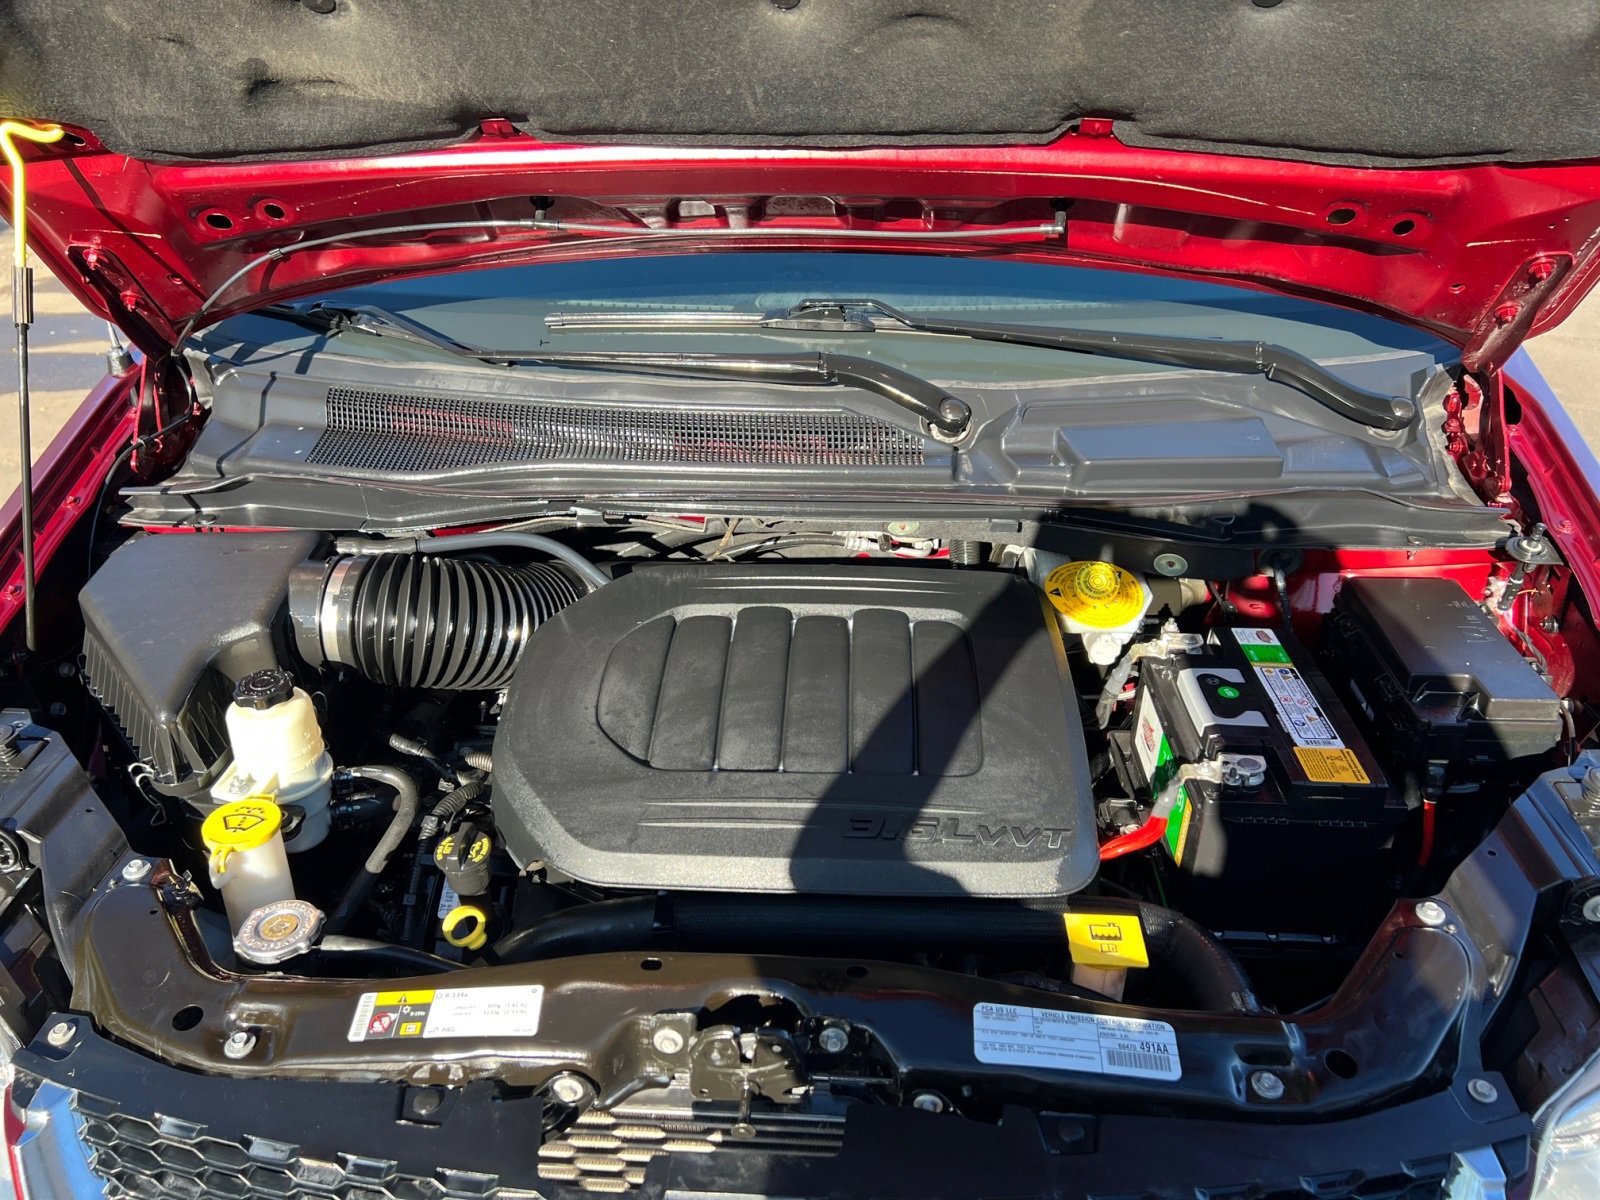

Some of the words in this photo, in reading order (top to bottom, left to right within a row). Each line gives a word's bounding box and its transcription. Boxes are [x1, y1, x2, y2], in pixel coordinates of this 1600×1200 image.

[1005, 1007, 1017, 1015] LLC
[1041, 1011, 1065, 1020] VEHICLE
[1066, 1013, 1095, 1023] EMISSION
[1096, 1017, 1122, 1026] CONTROL
[1124, 1020, 1165, 1030] INFORMATION
[1139, 1041, 1169, 1054] 491AA
